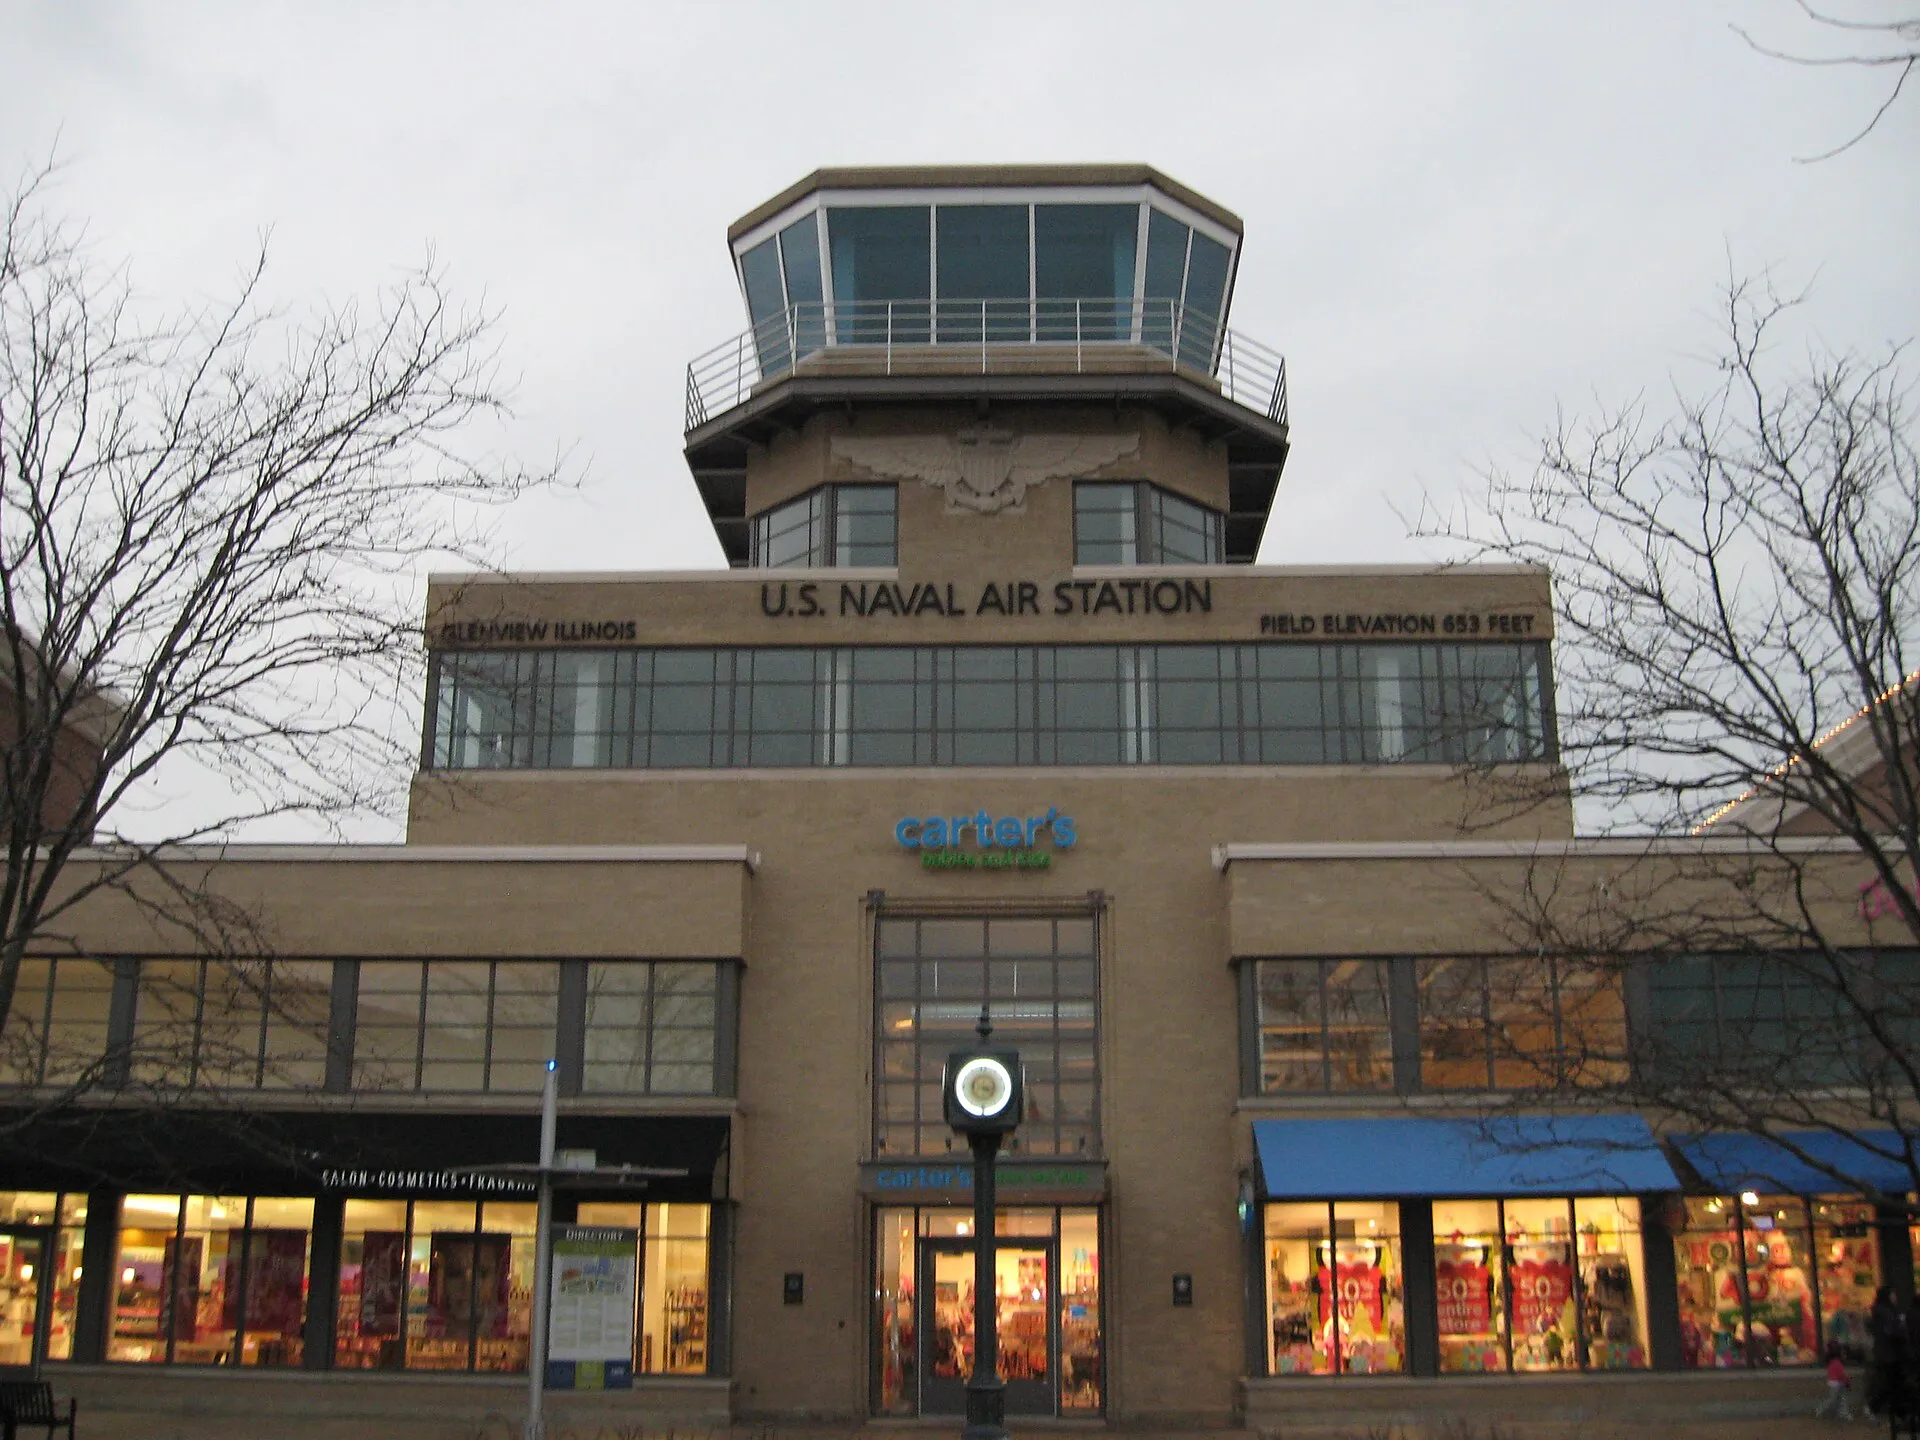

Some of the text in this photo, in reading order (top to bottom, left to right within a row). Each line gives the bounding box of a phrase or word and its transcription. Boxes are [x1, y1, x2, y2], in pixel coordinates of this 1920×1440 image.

[761, 578, 1212, 617] U.S. NAVAL AIR STATION
[554, 619, 637, 642] ILLINOIS
[1261, 613, 1536, 634] FIELD ELEVATION 653 FEET
[895, 805, 1077, 849] carter's
[321, 1168, 368, 1188] SALON
[378, 1168, 458, 1190] COSMETICS
